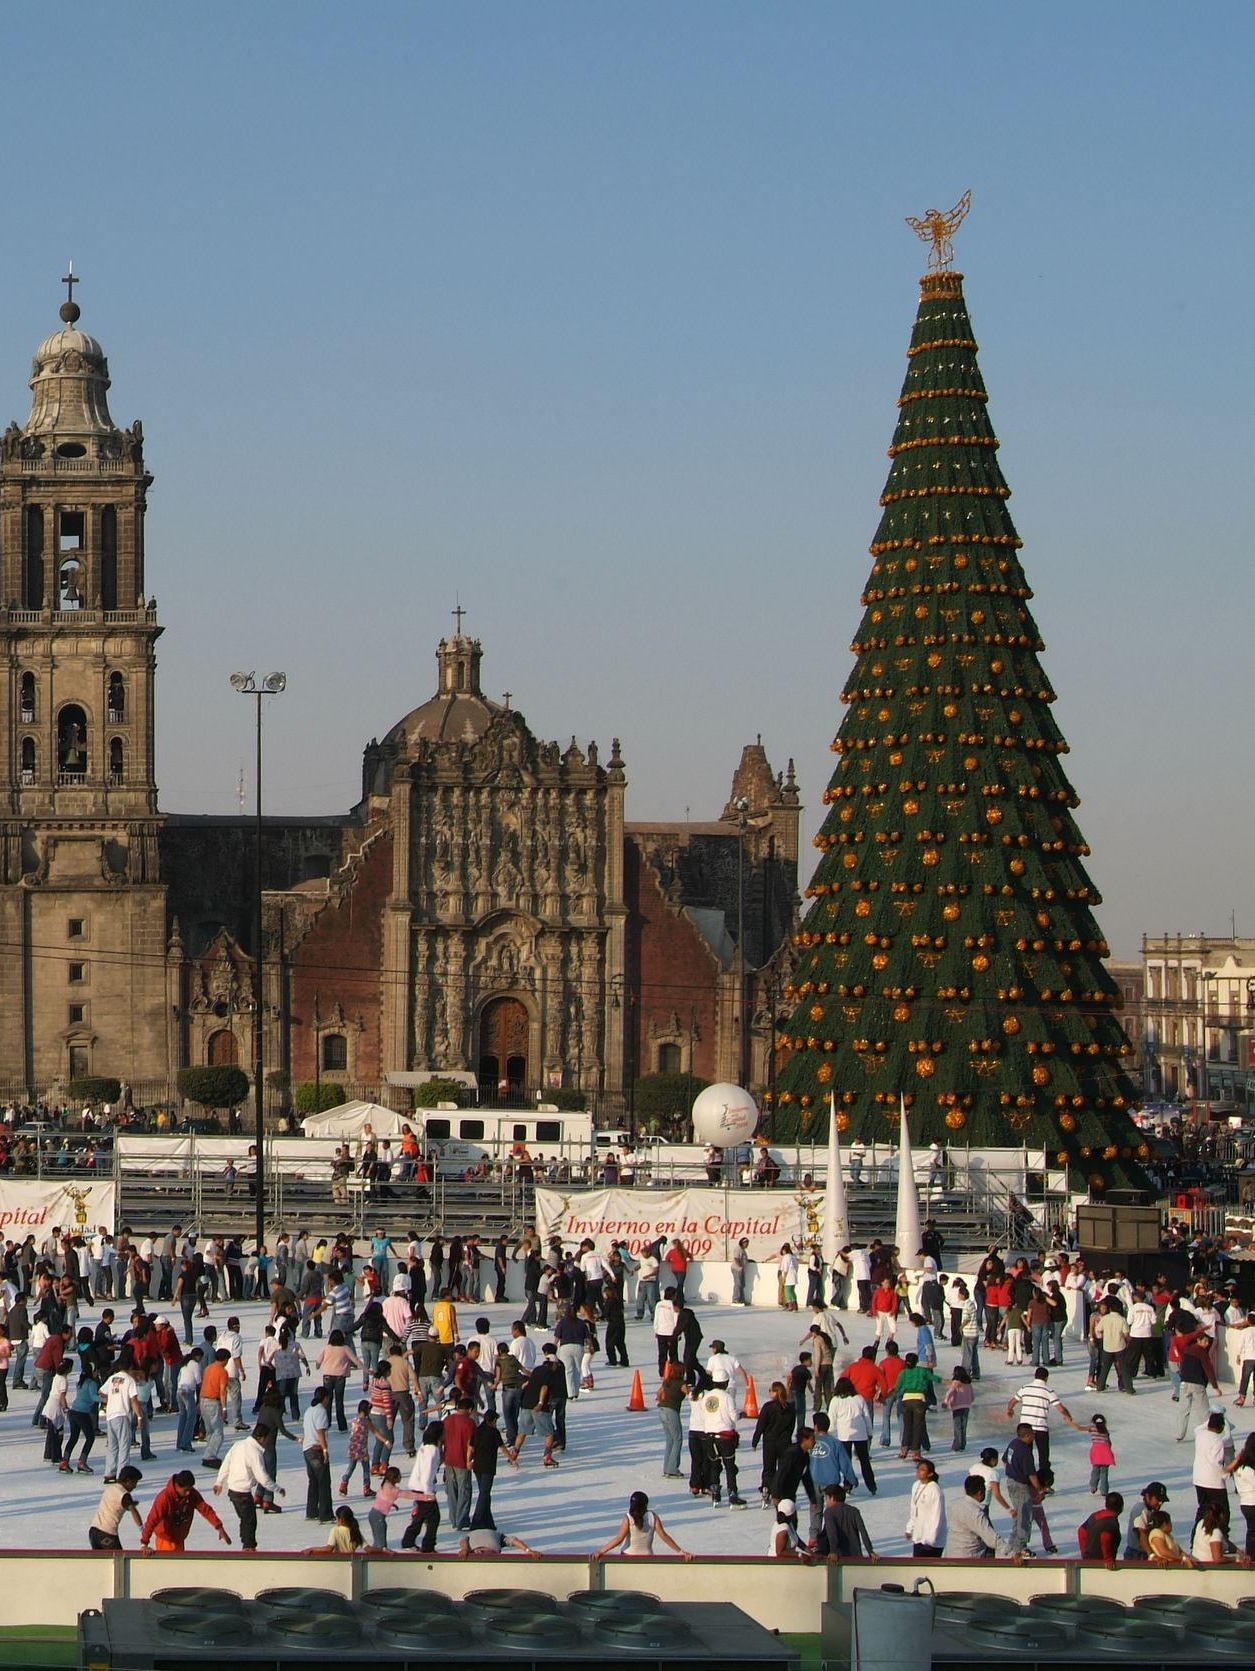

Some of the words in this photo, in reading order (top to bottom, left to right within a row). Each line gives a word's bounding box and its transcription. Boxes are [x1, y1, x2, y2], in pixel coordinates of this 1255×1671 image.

[566, 1216, 650, 1234] Invierno
[655, 1221, 676, 1233] en
[681, 1217, 698, 1233] la
[704, 1215, 779, 1239] Capital
[681, 1239, 712, 1256] 009
